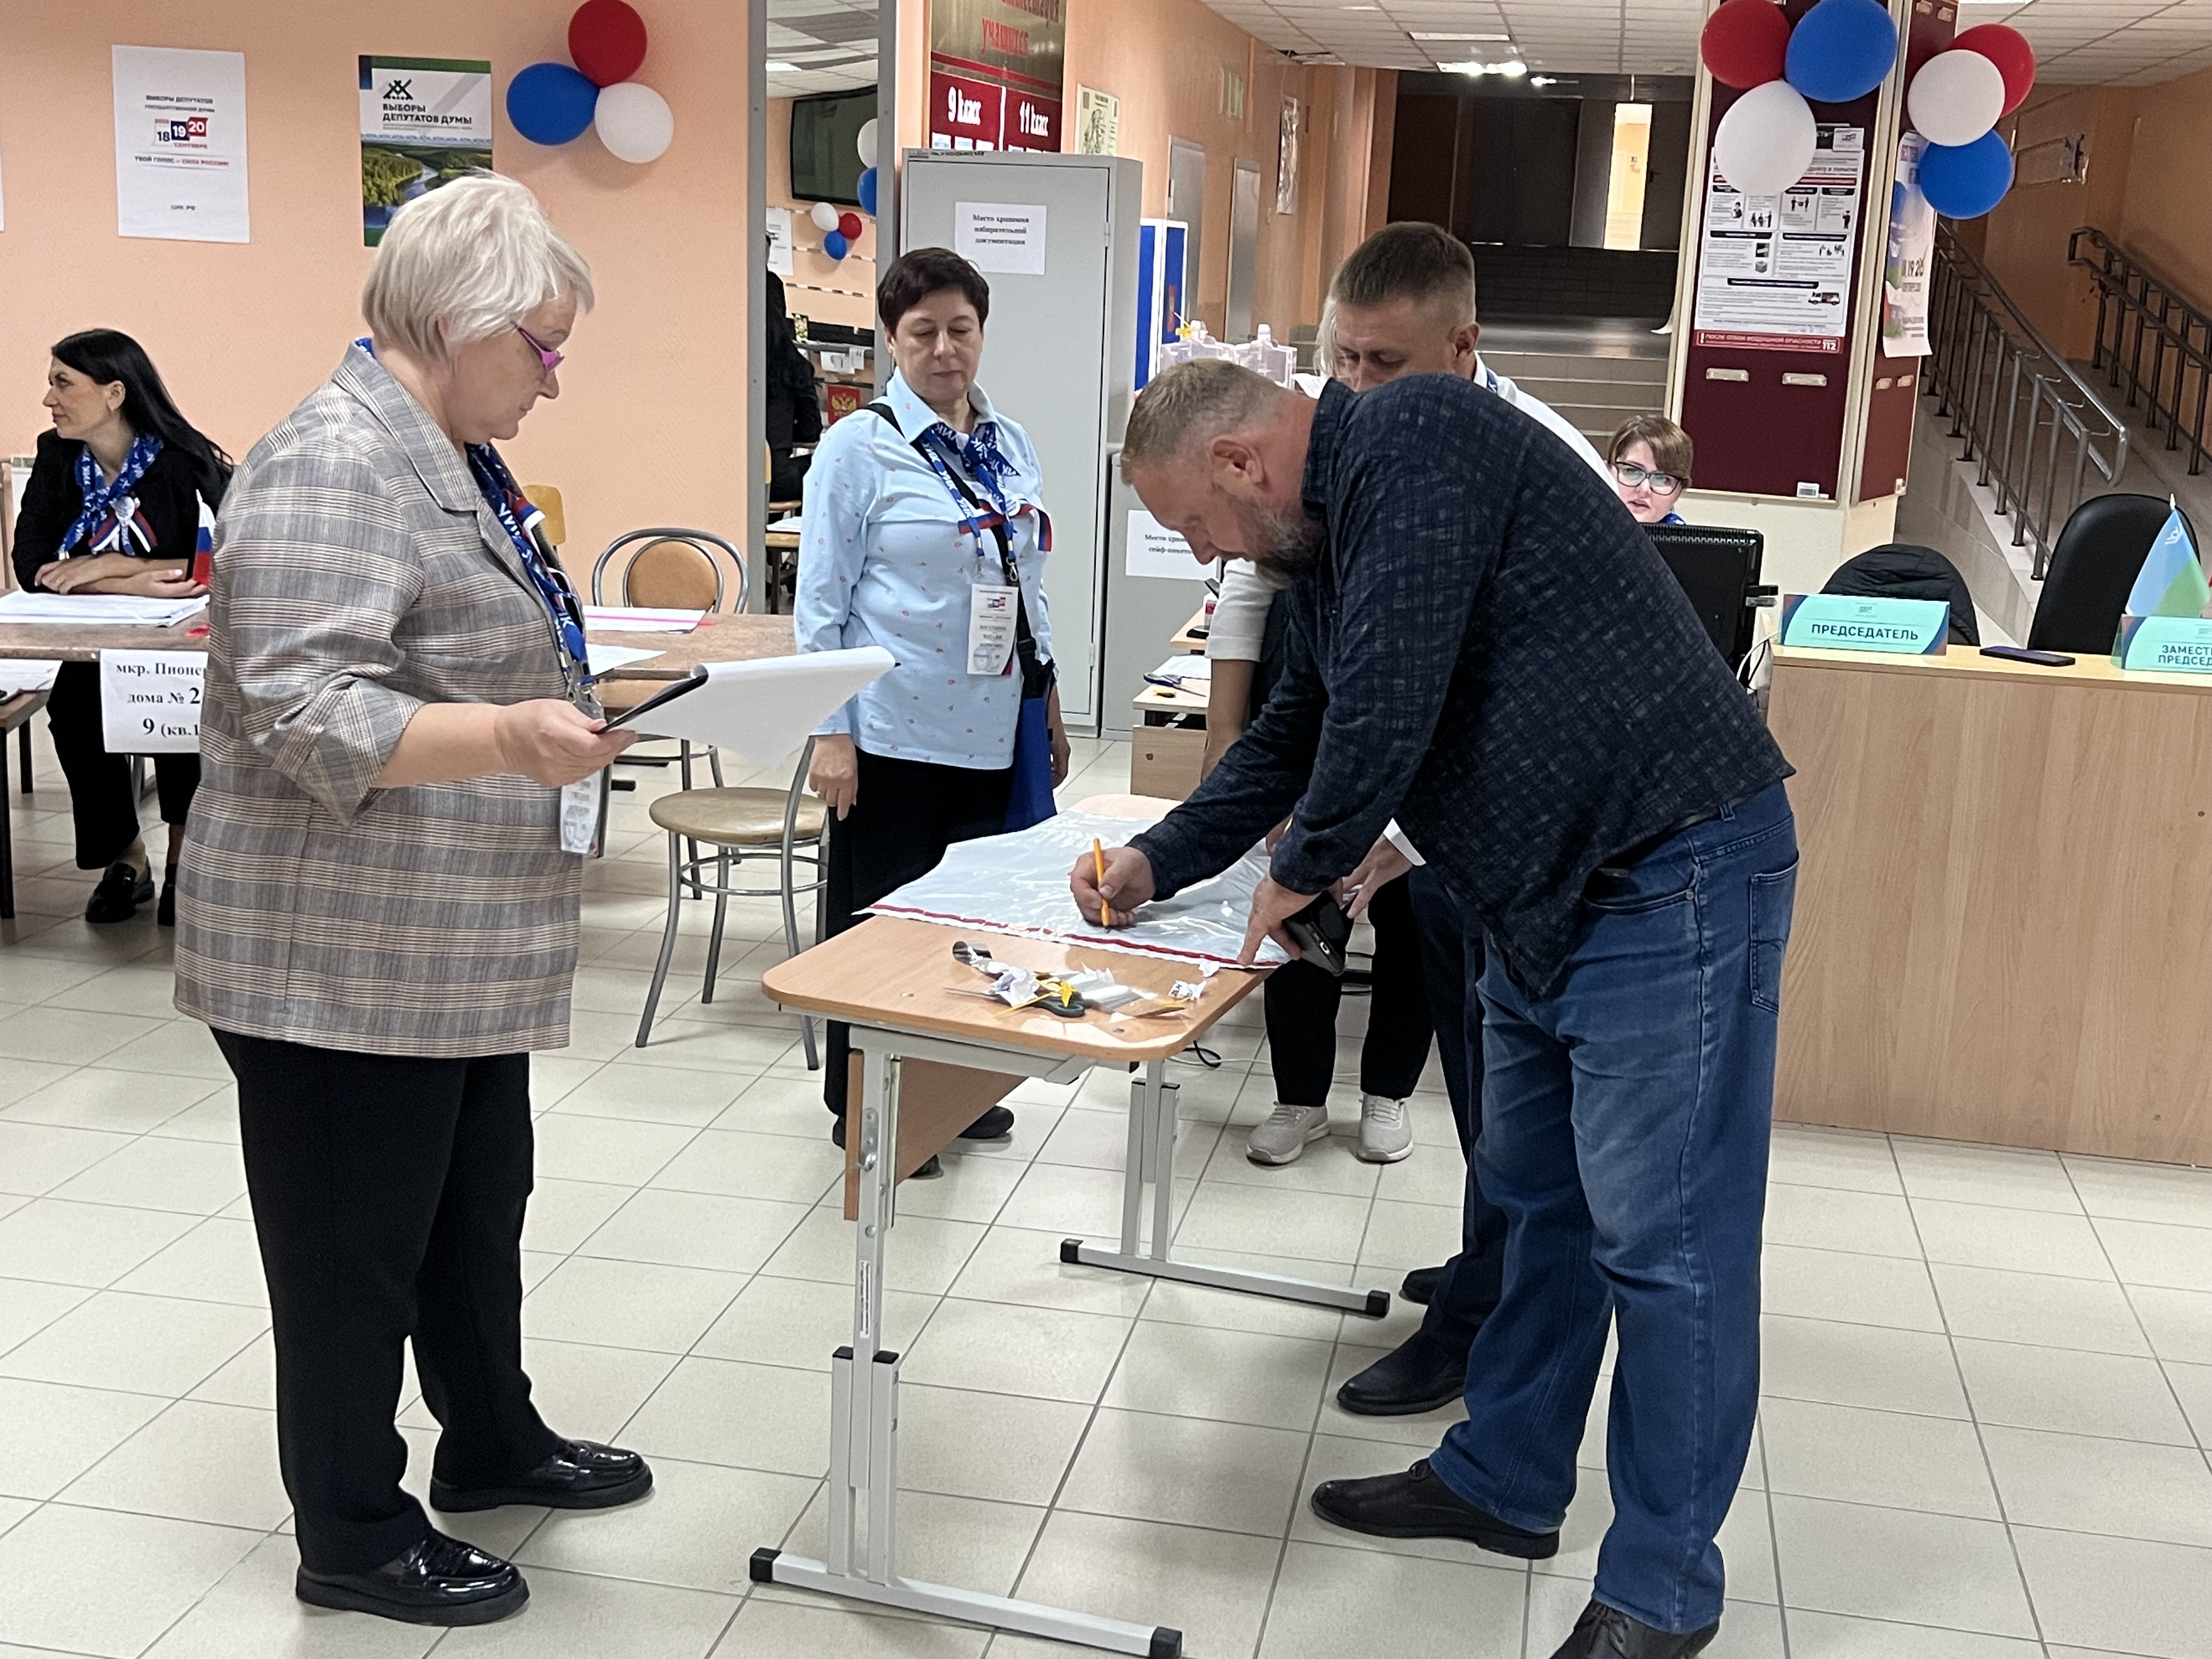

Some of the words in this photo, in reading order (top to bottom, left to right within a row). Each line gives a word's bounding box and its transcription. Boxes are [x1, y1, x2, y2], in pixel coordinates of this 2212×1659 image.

[383, 104, 426, 112] ВЫБОРЫ
[948, 86, 956, 122] 9
[383, 113, 439, 123] ДЕПУТАТОВ
[441, 116, 472, 126] ДУМЫ
[1019, 101, 1030, 133] 11
[157, 131, 171, 142] 18
[172, 125, 187, 138] 19
[188, 121, 205, 133] 20
[1822, 341, 1837, 351] 112
[1812, 624, 1918, 640] ПРЕДСЕДАТЕЛЬ
[2162, 645, 2212, 655] ЗАМЕСТ
[116, 664, 150, 676] мкр.
[127, 693, 163, 704] дома
[167, 692, 184, 704] №
[189, 687, 201, 704] 2
[143, 718, 155, 735] 9
